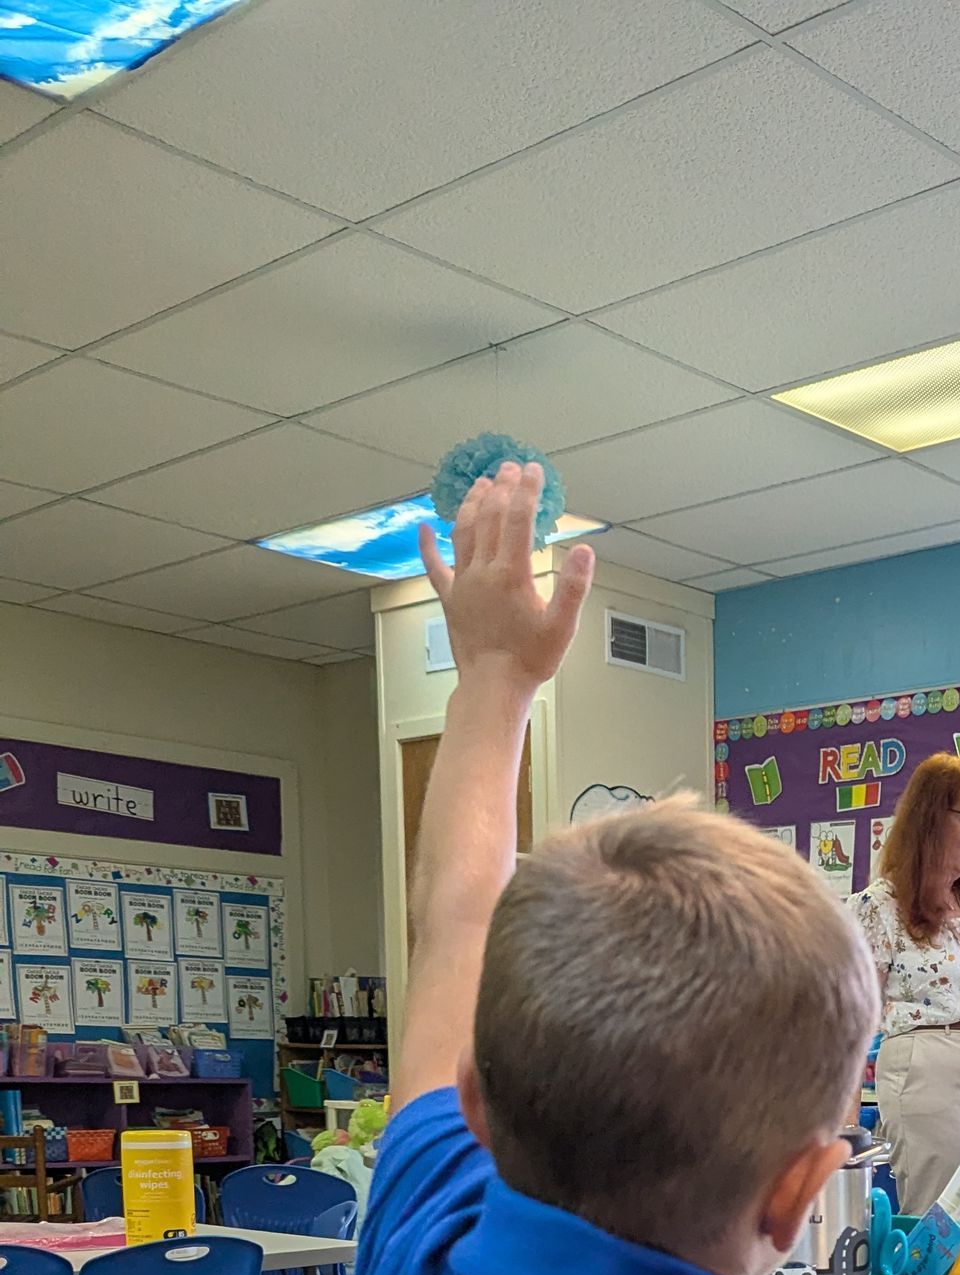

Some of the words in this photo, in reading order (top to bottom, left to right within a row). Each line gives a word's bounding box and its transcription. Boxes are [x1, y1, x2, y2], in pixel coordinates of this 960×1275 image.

[819, 738, 906, 784] READ
[70, 786, 138, 816] write
[128, 1169, 183, 1180] disinfecting
[140, 1181, 169, 1190] wipes
